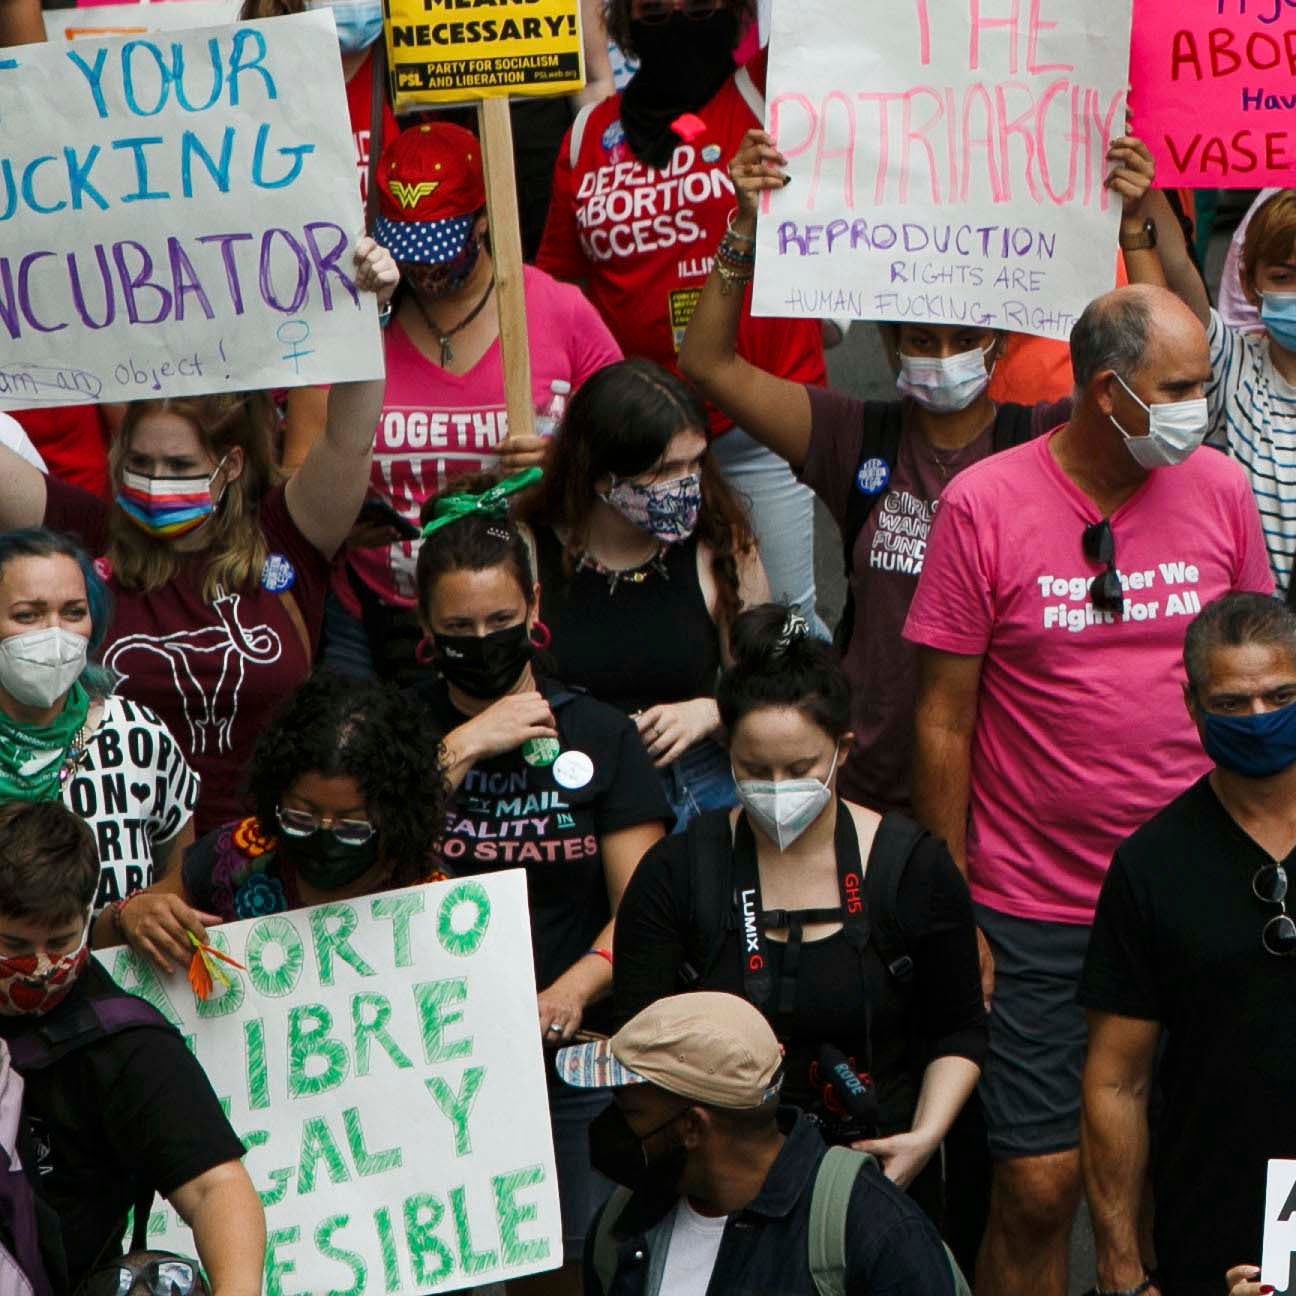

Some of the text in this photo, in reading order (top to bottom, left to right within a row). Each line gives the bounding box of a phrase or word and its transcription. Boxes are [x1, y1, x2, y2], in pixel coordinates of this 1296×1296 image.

[392, 14, 577, 48] NECESSARY!
[427, 54, 559, 75] PARTY FOR SOCIALISM
[777, 219, 1057, 258] REPRODUCTION
[890, 261, 1046, 292] RIGHTS ARE
[1121, 599, 1159, 624] for
[1165, 591, 1201, 617] All
[495, 791, 569, 818] MAIL
[474, 834, 597, 862] STATES
[843, 872, 862, 914] GH5
[741, 888, 759, 953] LUMIX
